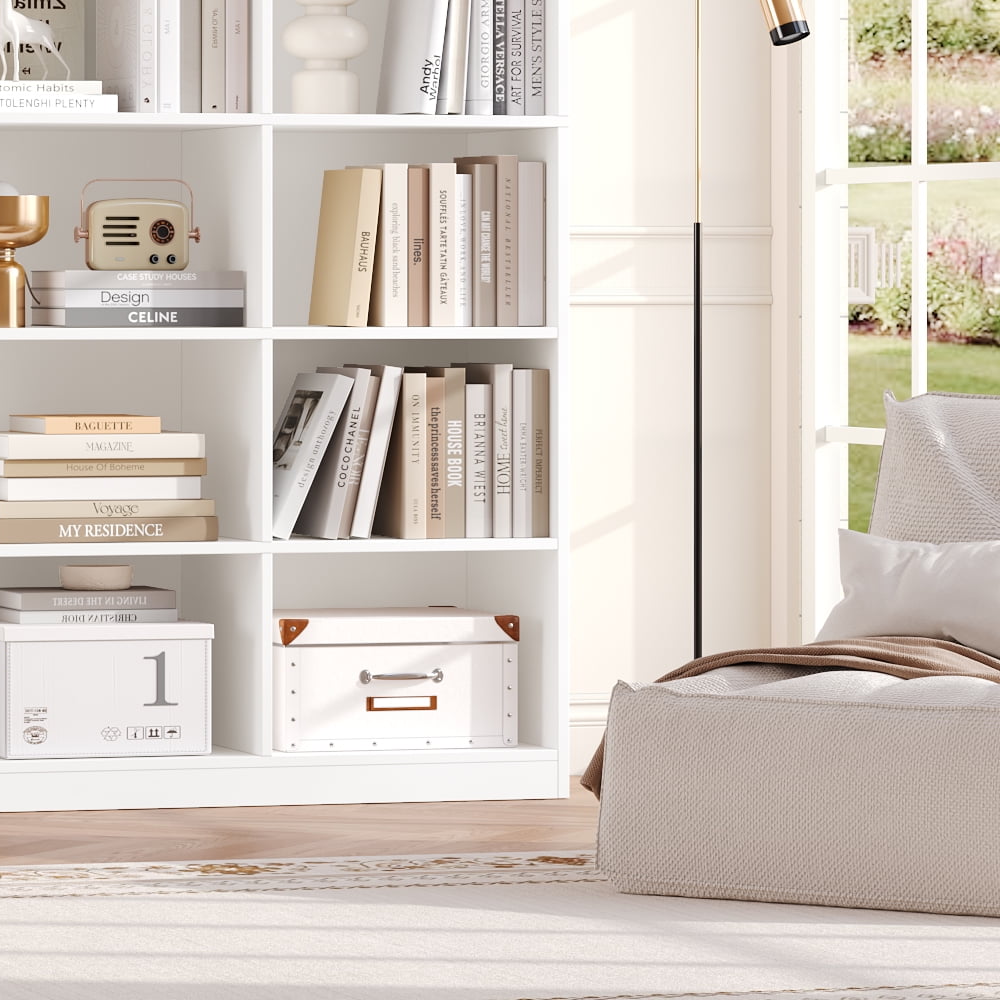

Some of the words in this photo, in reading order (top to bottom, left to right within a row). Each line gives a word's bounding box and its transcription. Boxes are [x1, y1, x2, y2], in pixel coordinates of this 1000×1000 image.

[511, 10, 521, 57] SURVIVAL
[532, 10, 542, 52] STYLE
[481, 32, 490, 88] GIORGIO
[496, 39, 505, 102] VERSACE
[511, 61, 521, 81] FOR
[36, 84, 74, 93] Habits
[420, 59, 434, 94] Andy
[532, 56, 542, 97] MEN'S
[55, 99, 95, 108] PLENTY
[511, 86, 521, 105] ART
[358, 231, 370, 273] BAUHAUS
[117, 273, 138, 281] CASE
[139, 273, 164, 281] STUDY
[165, 273, 197, 281] HOUSES
[101, 291, 149, 306] Design
[128, 312, 178, 323] CELINE
[75, 421, 132, 430] BAGUETTE
[431, 407, 441, 422] the
[85, 441, 135, 452] MAGAZINE
[411, 412, 420, 465] IMMUNITY
[428, 423, 441, 461] princess
[447, 420, 462, 455] HOUSE
[474, 413, 485, 465] BRIANNA
[66, 463, 93, 471] House
[96, 463, 107, 471] Of
[109, 462, 145, 471] Boheme
[431, 462, 439, 487] saves
[447, 457, 462, 487] BOOK
[497, 454, 510, 494] HOME
[474, 471, 485, 504] WIEST
[92, 502, 139, 517] Voyage
[431, 487, 441, 520] herself
[59, 524, 82, 538] MY
[84, 523, 163, 538] RESIDENCE
[143, 651, 179, 706] 1
